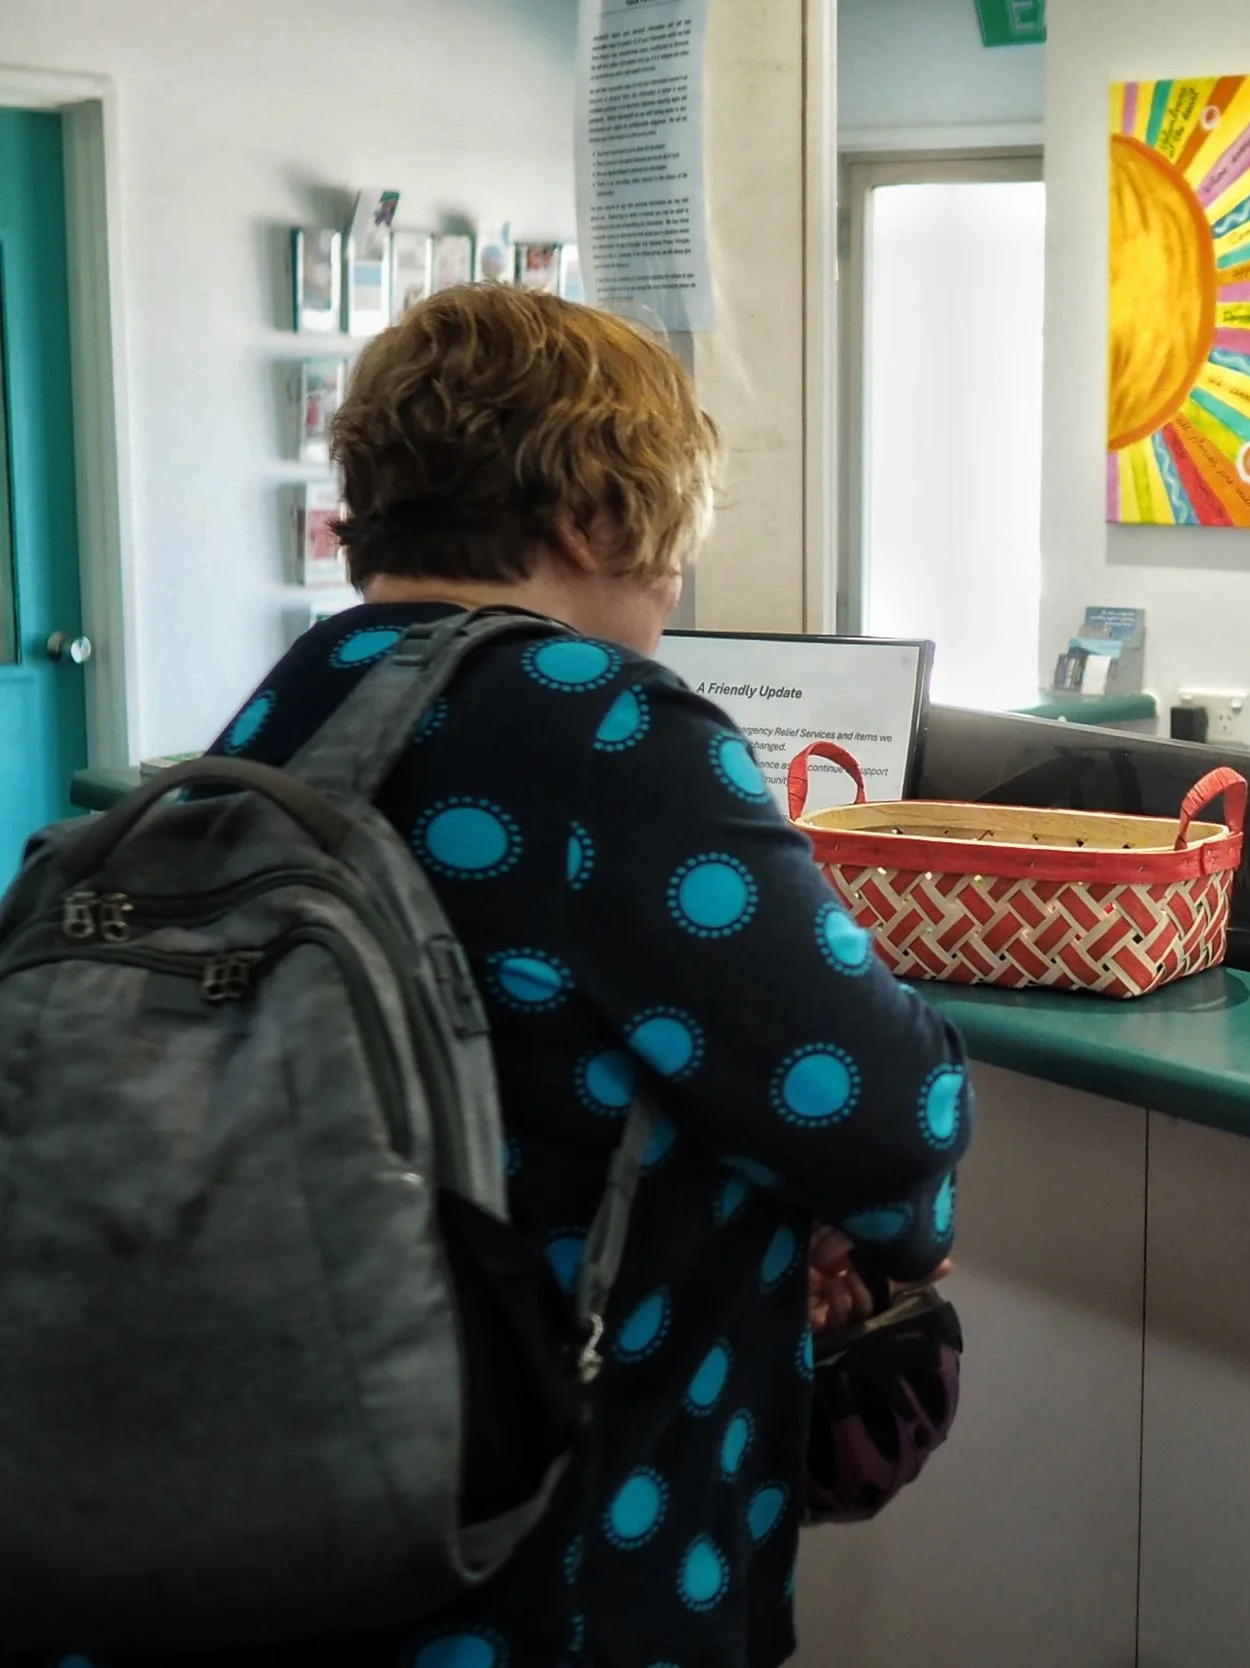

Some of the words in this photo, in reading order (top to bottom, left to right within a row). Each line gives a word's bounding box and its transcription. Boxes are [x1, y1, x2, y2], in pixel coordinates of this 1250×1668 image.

[696, 682, 705, 694] A
[707, 682, 758, 699] Friendly
[759, 685, 803, 700] Update
[773, 726, 800, 737] Relief
[800, 728, 836, 740] Services
[836, 731, 854, 740] and
[854, 731, 879, 741] items
[879, 734, 893, 743] we
[860, 767, 889, 777] upport
